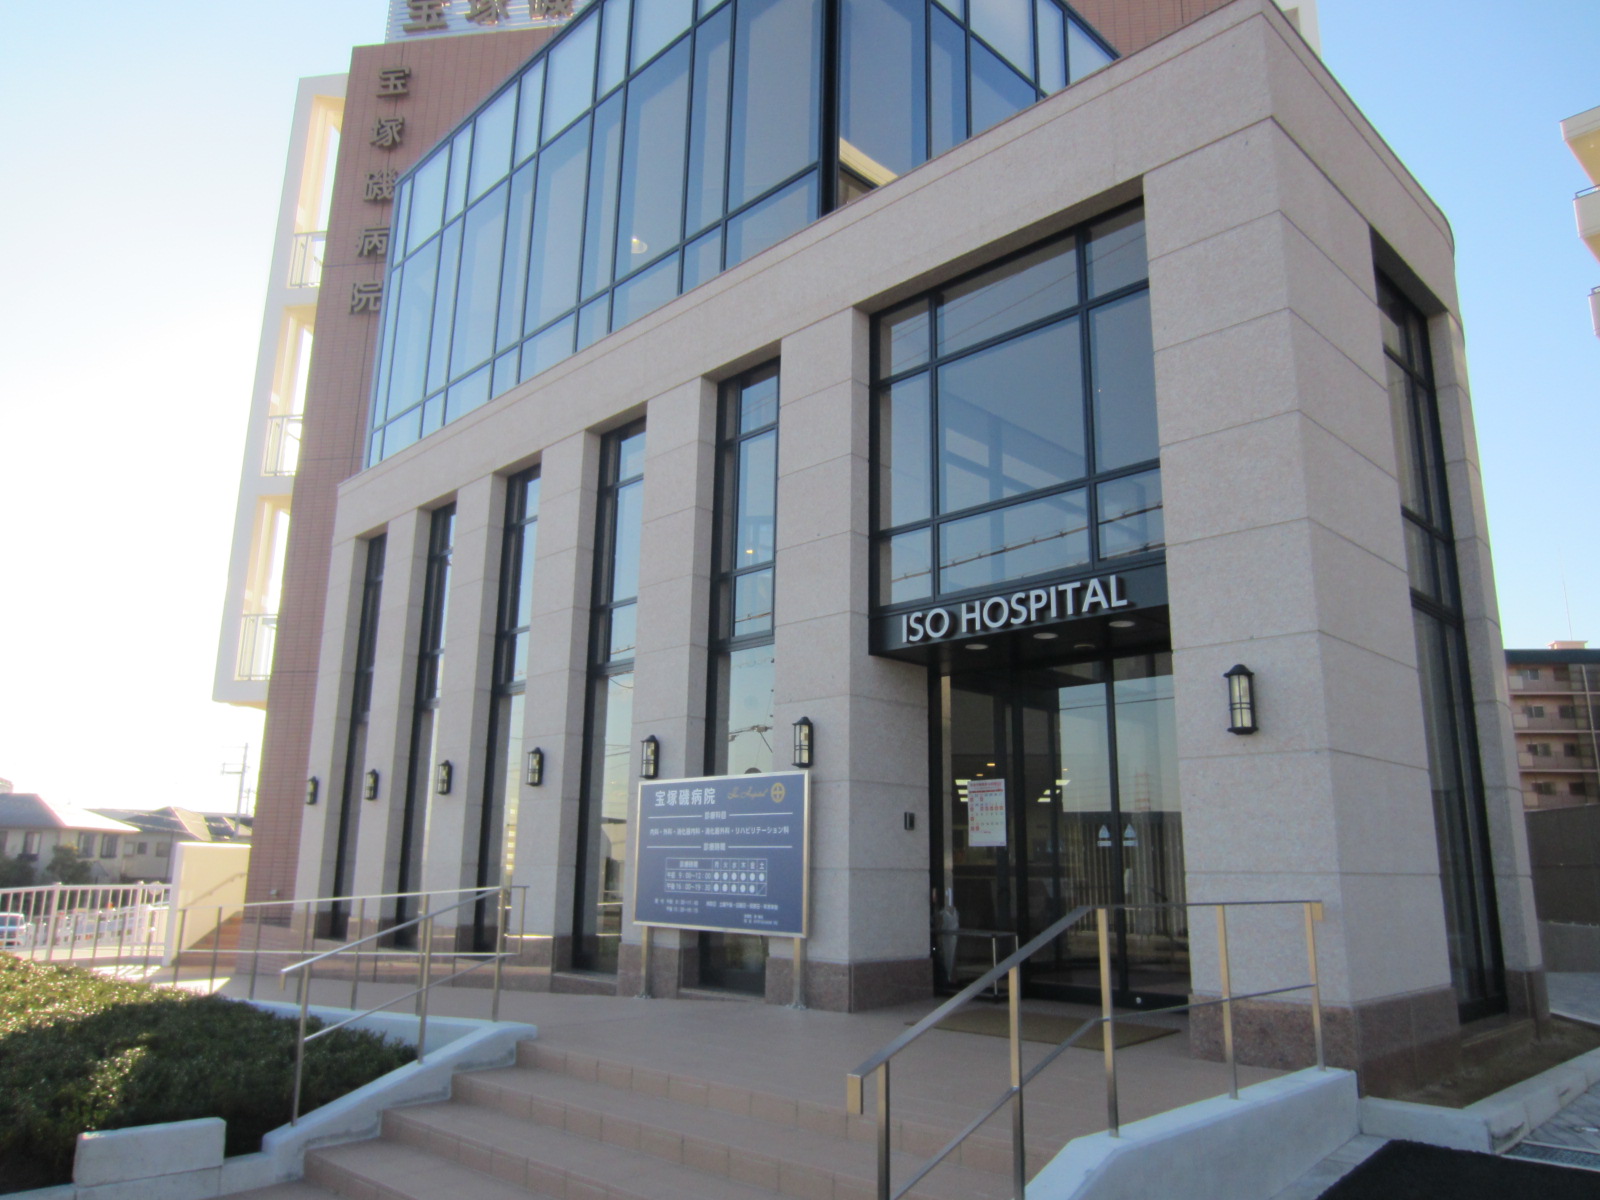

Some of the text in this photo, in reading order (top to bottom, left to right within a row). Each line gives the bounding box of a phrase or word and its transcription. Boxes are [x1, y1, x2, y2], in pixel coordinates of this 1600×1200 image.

[902, 575, 1128, 643] ISO HOSPITAL
[655, 788, 716, 806] 宝塚磯病院
